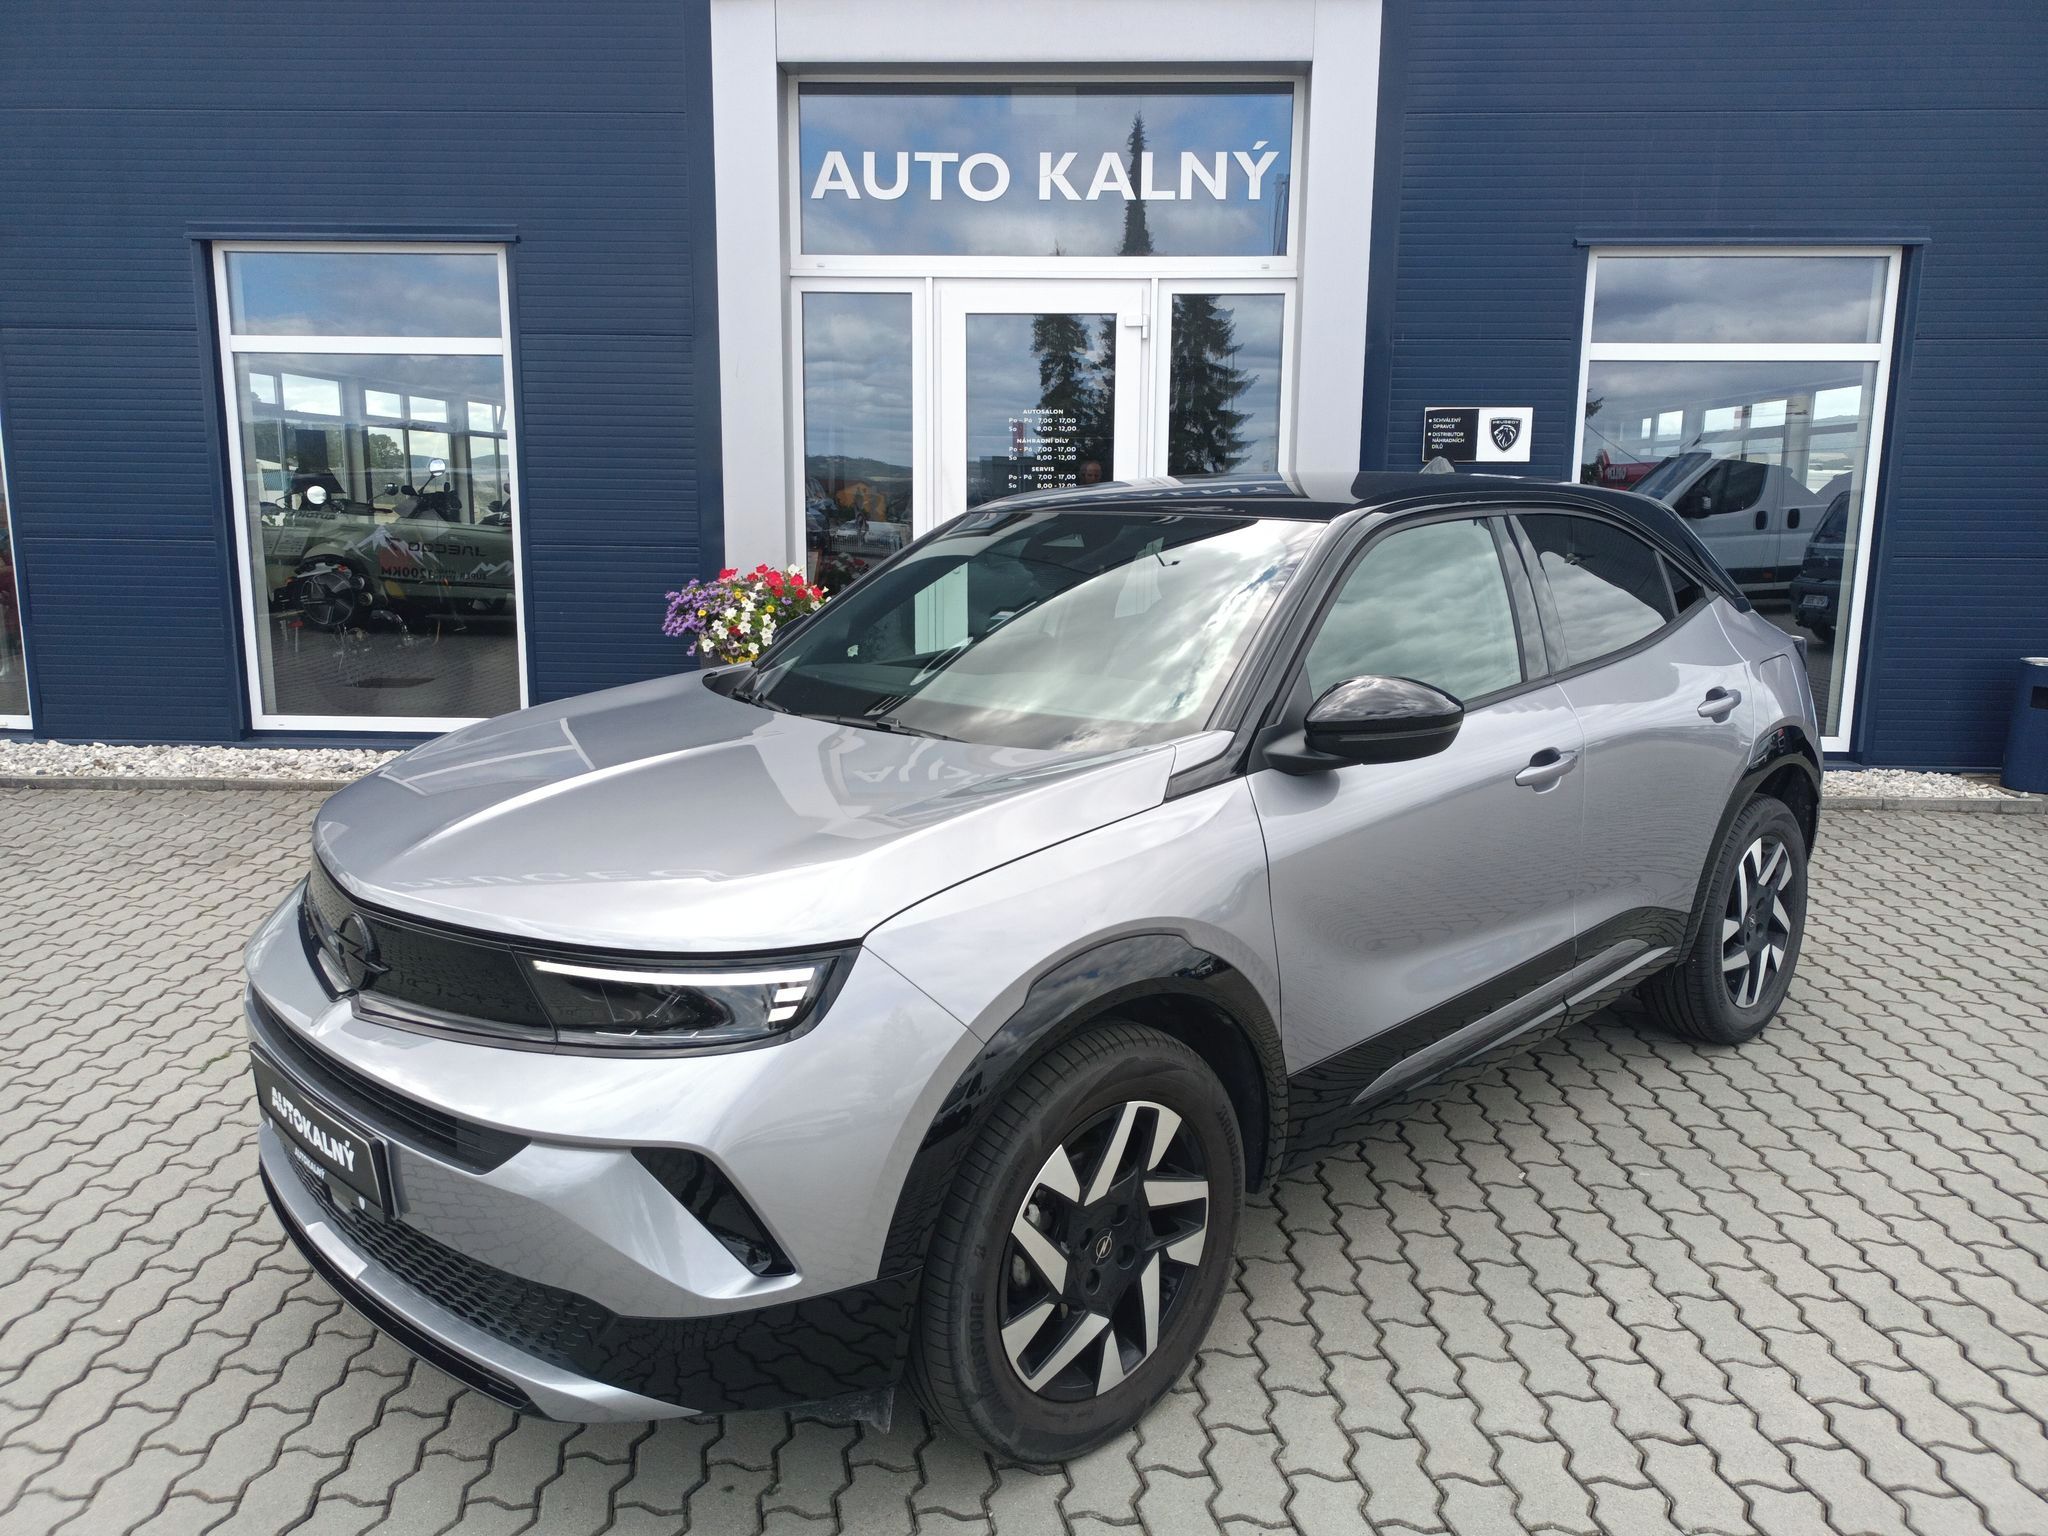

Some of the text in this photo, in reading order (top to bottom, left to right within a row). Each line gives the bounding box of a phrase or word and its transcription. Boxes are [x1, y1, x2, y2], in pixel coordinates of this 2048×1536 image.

[811, 141, 1280, 201] AUTO KALNÝ
[271, 1086, 355, 1173] AUTOKALNÝ
